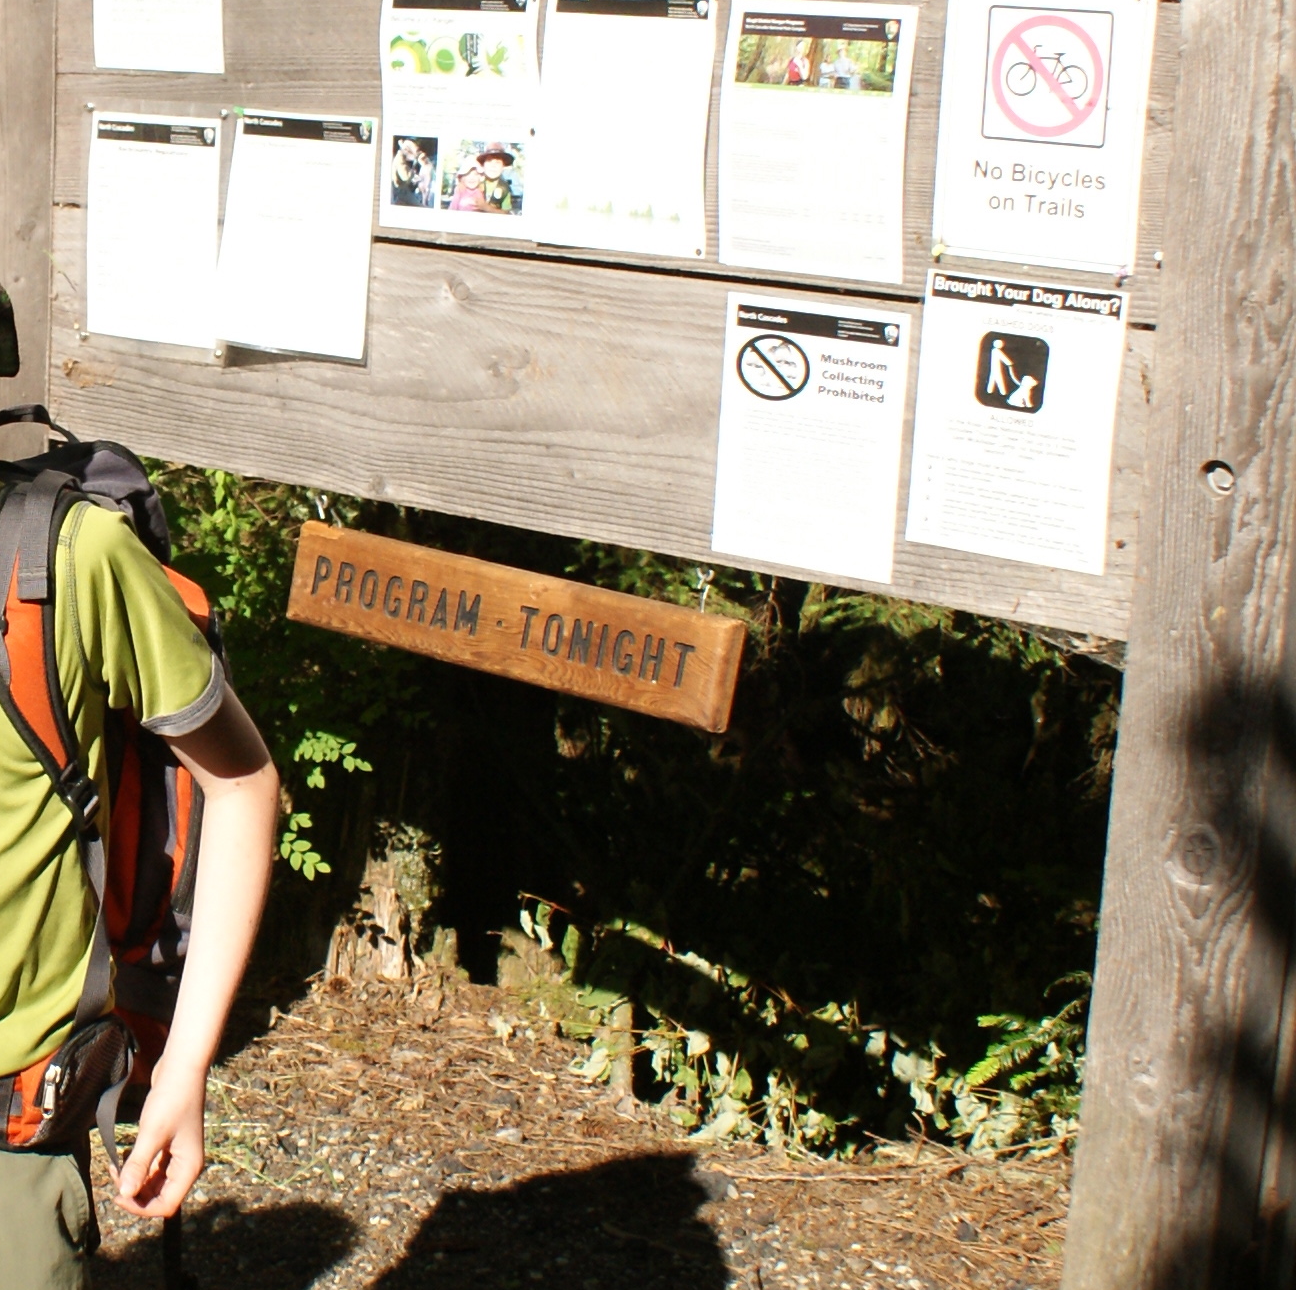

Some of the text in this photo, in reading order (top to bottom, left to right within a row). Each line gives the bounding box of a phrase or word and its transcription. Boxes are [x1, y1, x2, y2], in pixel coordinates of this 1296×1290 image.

[973, 160, 1106, 190] No Bicycles
[989, 194, 1085, 218] on Trails
[934, 276, 1120, 315] Brought Your Dog Along?
[820, 354, 888, 371] Mushroom
[822, 370, 884, 389] Collecting
[817, 385, 885, 403] Prohibited
[989, 414, 1034, 428] ALLOWED
[311, 555, 696, 687] PROGRAM TONIGHT
